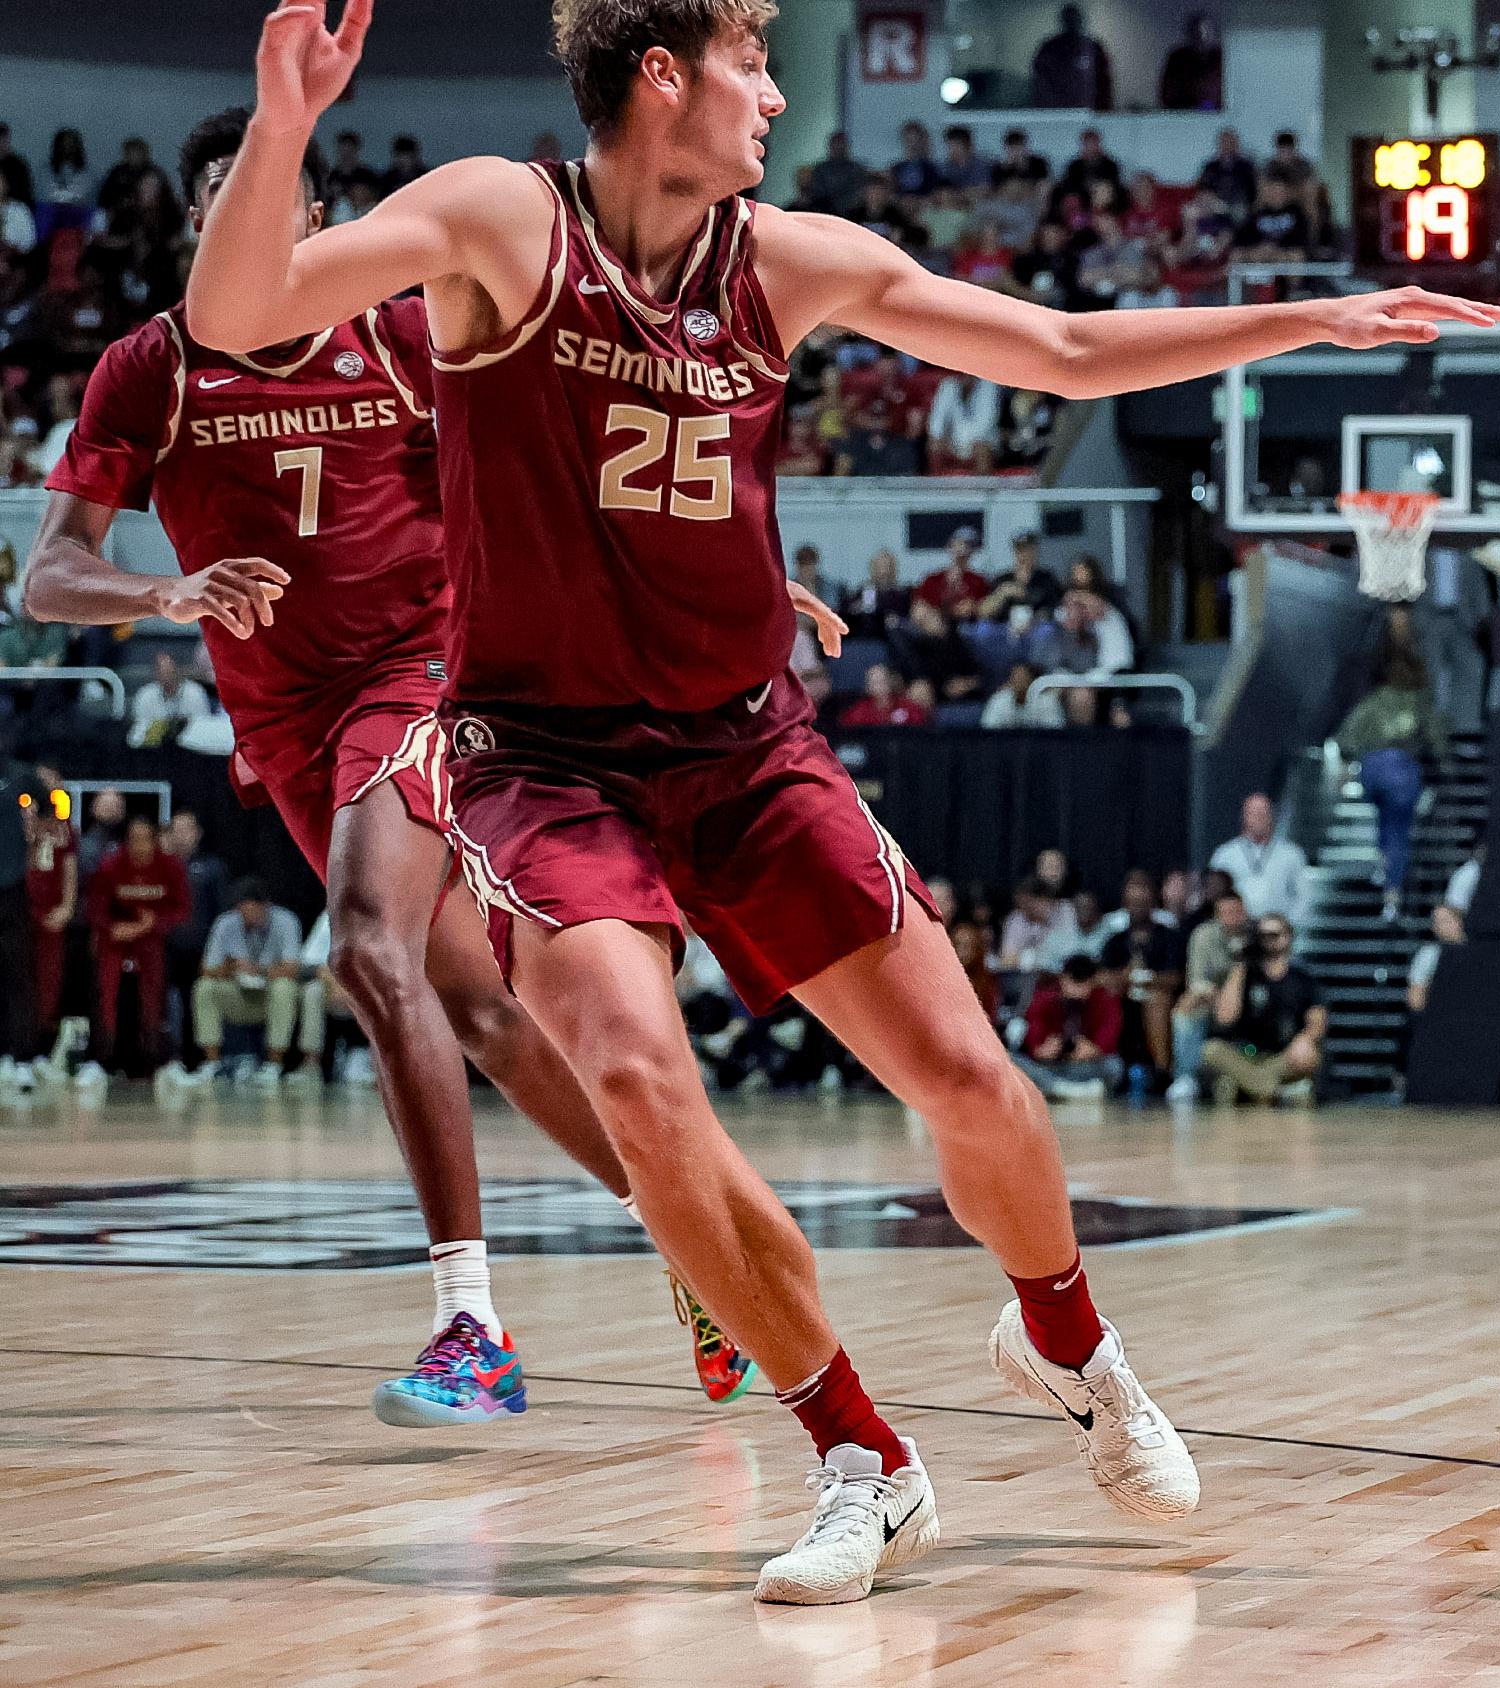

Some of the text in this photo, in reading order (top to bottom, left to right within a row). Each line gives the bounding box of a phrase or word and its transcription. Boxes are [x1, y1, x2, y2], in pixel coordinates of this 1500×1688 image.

[868, 21, 914, 74] R
[1406, 185, 1470, 260] 19
[189, 399, 399, 447] SEMINOLES
[273, 446, 323, 537] 7
[599, 403, 733, 521] 25
